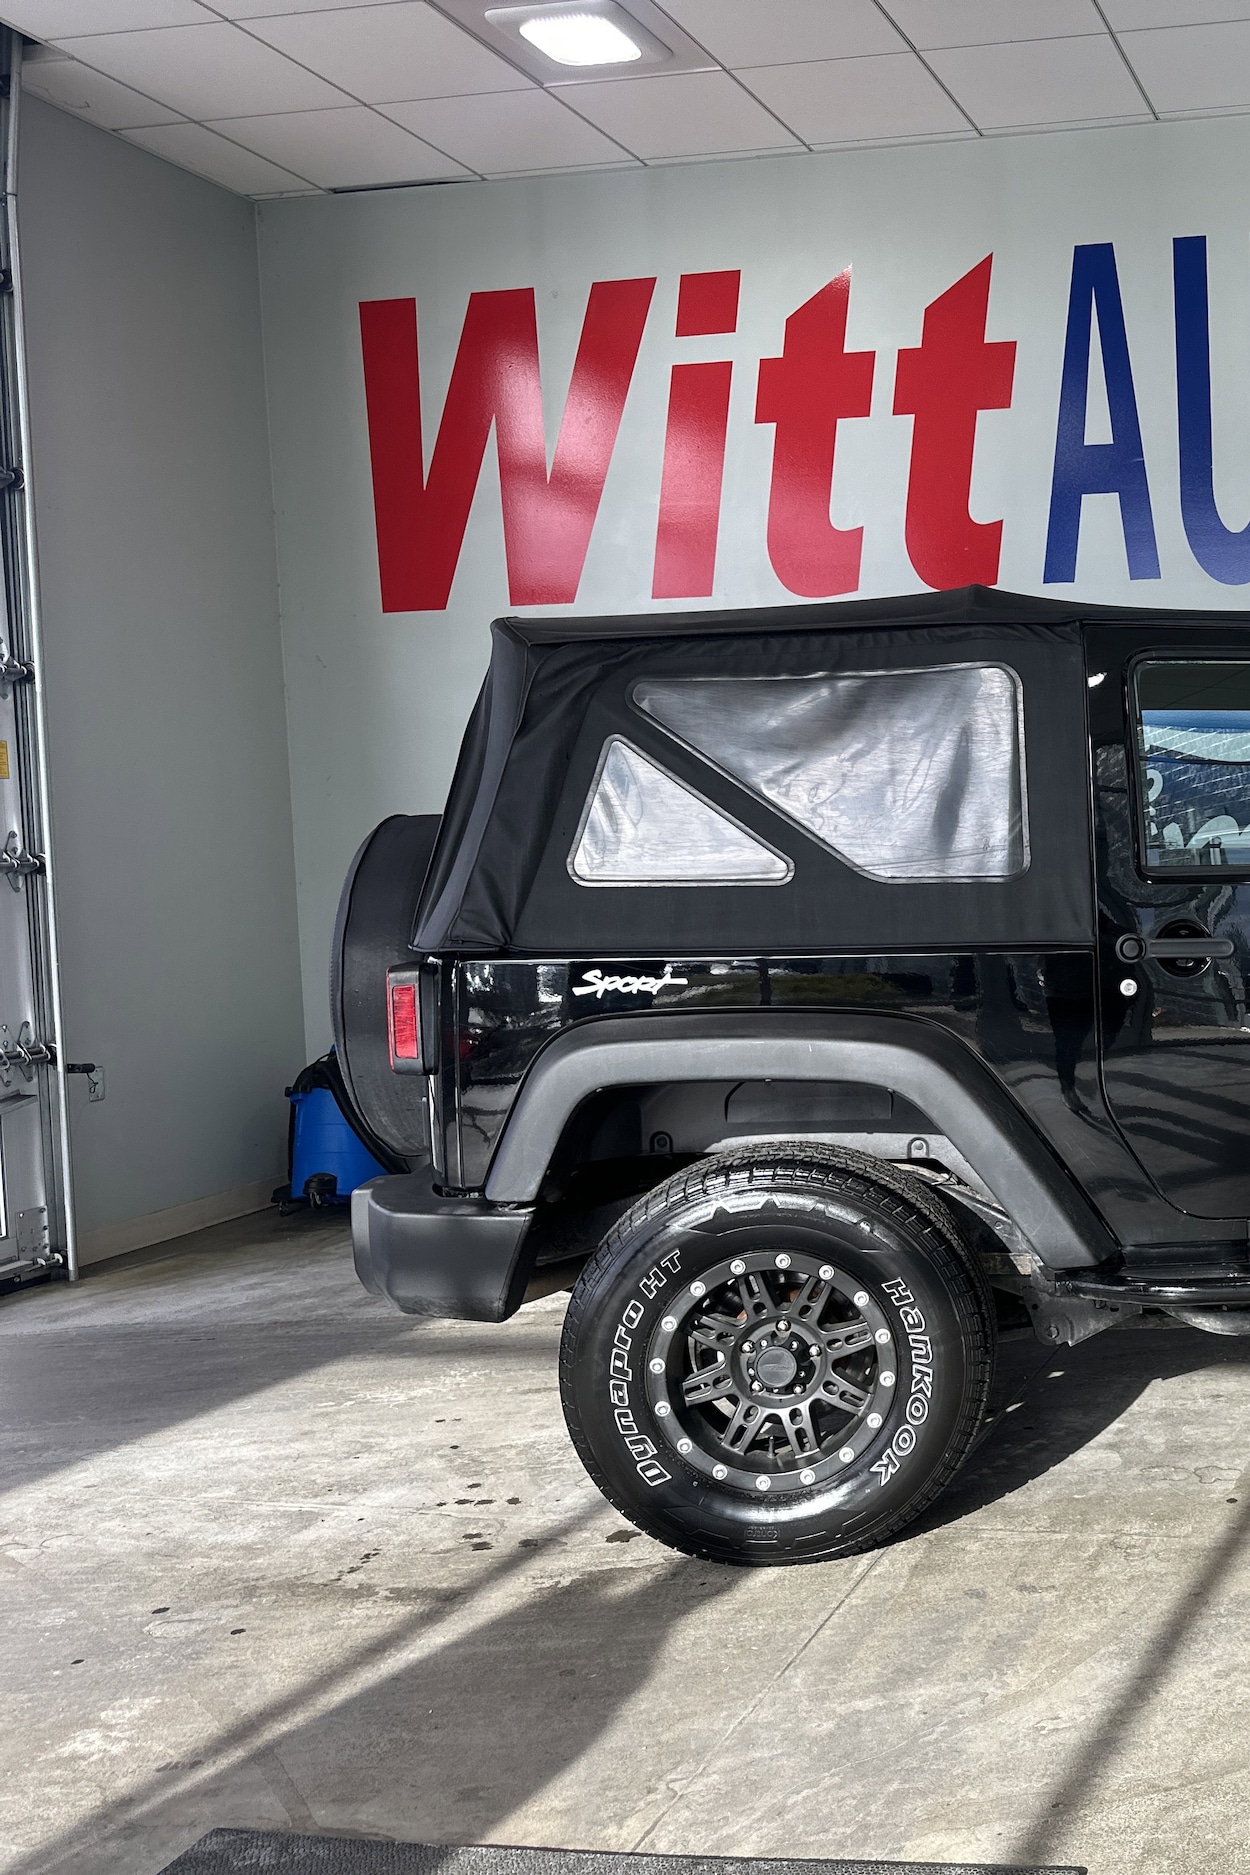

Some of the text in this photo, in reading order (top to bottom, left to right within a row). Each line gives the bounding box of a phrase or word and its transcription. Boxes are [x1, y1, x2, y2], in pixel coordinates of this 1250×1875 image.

[572, 969, 688, 999] Sport
[610, 1250, 682, 1486] Dynapro HT
